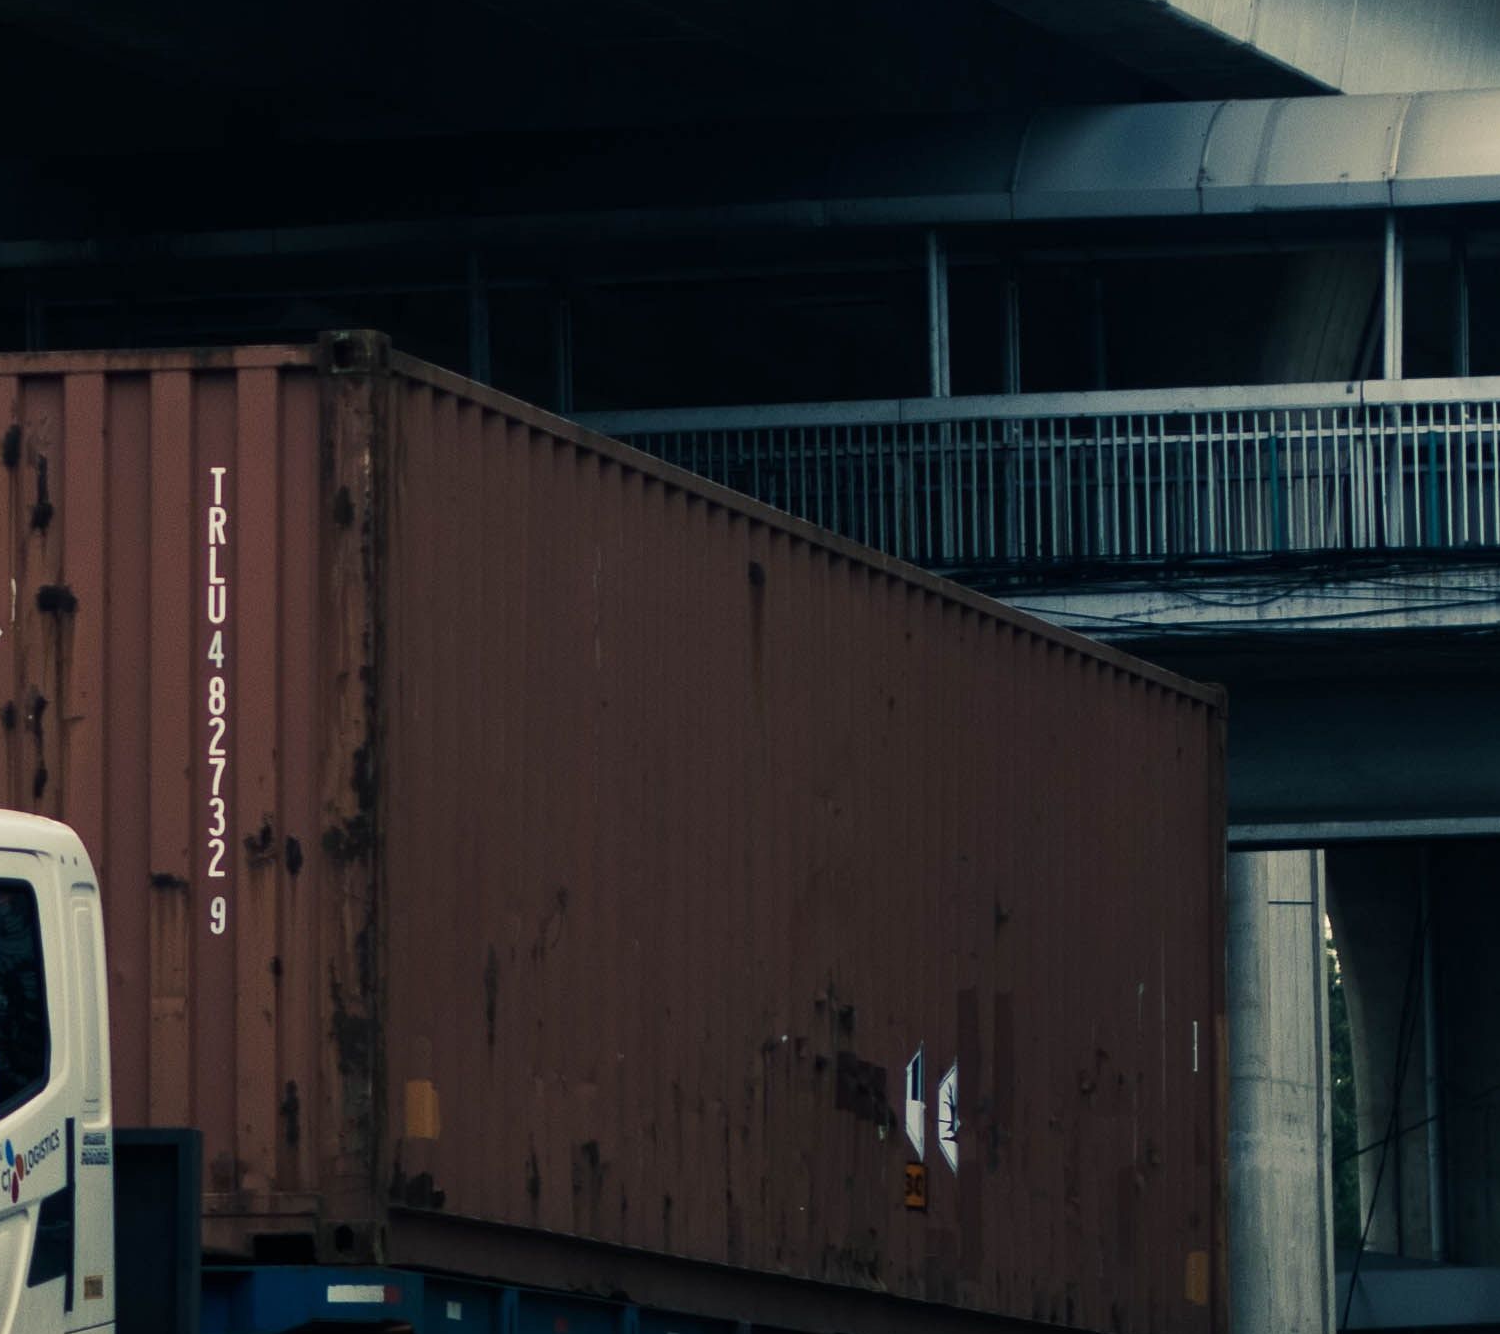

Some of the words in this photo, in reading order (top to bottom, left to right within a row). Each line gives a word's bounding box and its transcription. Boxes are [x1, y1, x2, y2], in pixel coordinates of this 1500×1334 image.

[207, 467, 227, 624] TRLU
[210, 896, 227, 935] 9
[24, 1129, 60, 1176] LOGISTICS
